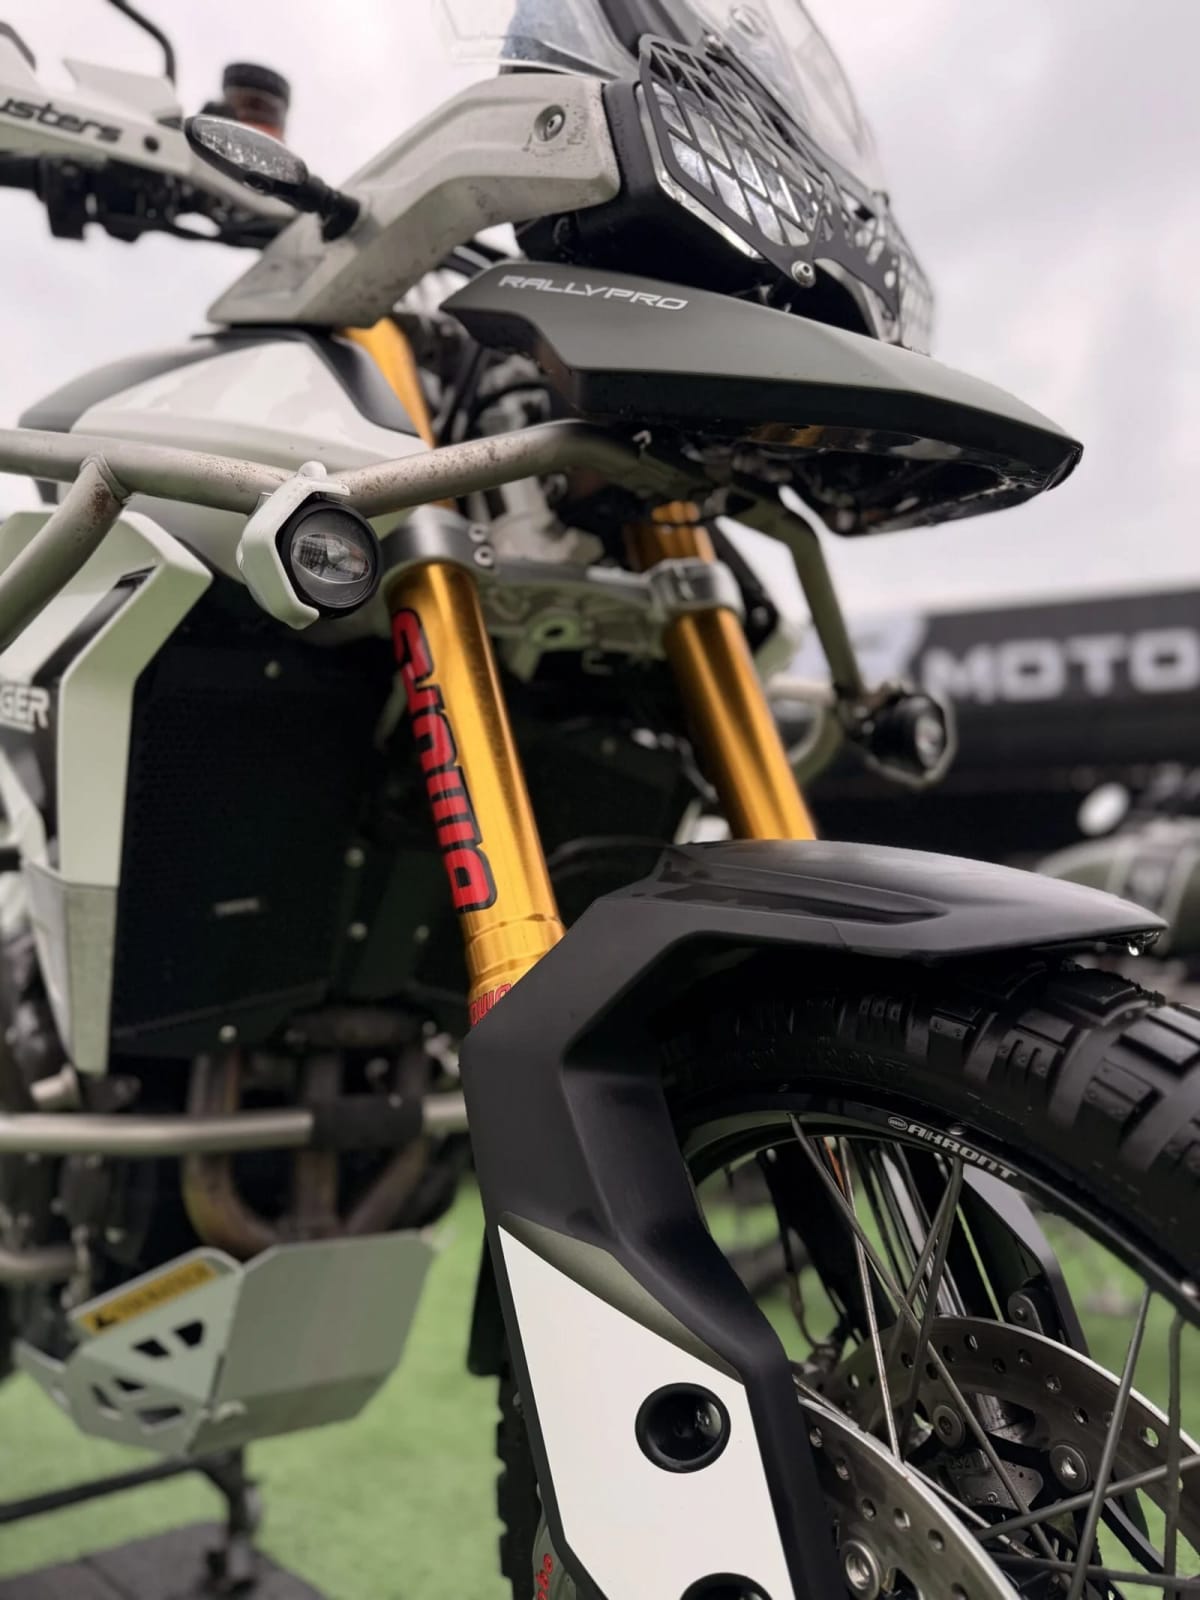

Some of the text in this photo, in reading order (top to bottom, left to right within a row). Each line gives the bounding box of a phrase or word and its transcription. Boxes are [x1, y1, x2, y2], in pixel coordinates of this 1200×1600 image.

[498, 275, 688, 310] RALLYPRO
[923, 627, 1200, 704] MOTO
[0, 686, 49, 730] GER
